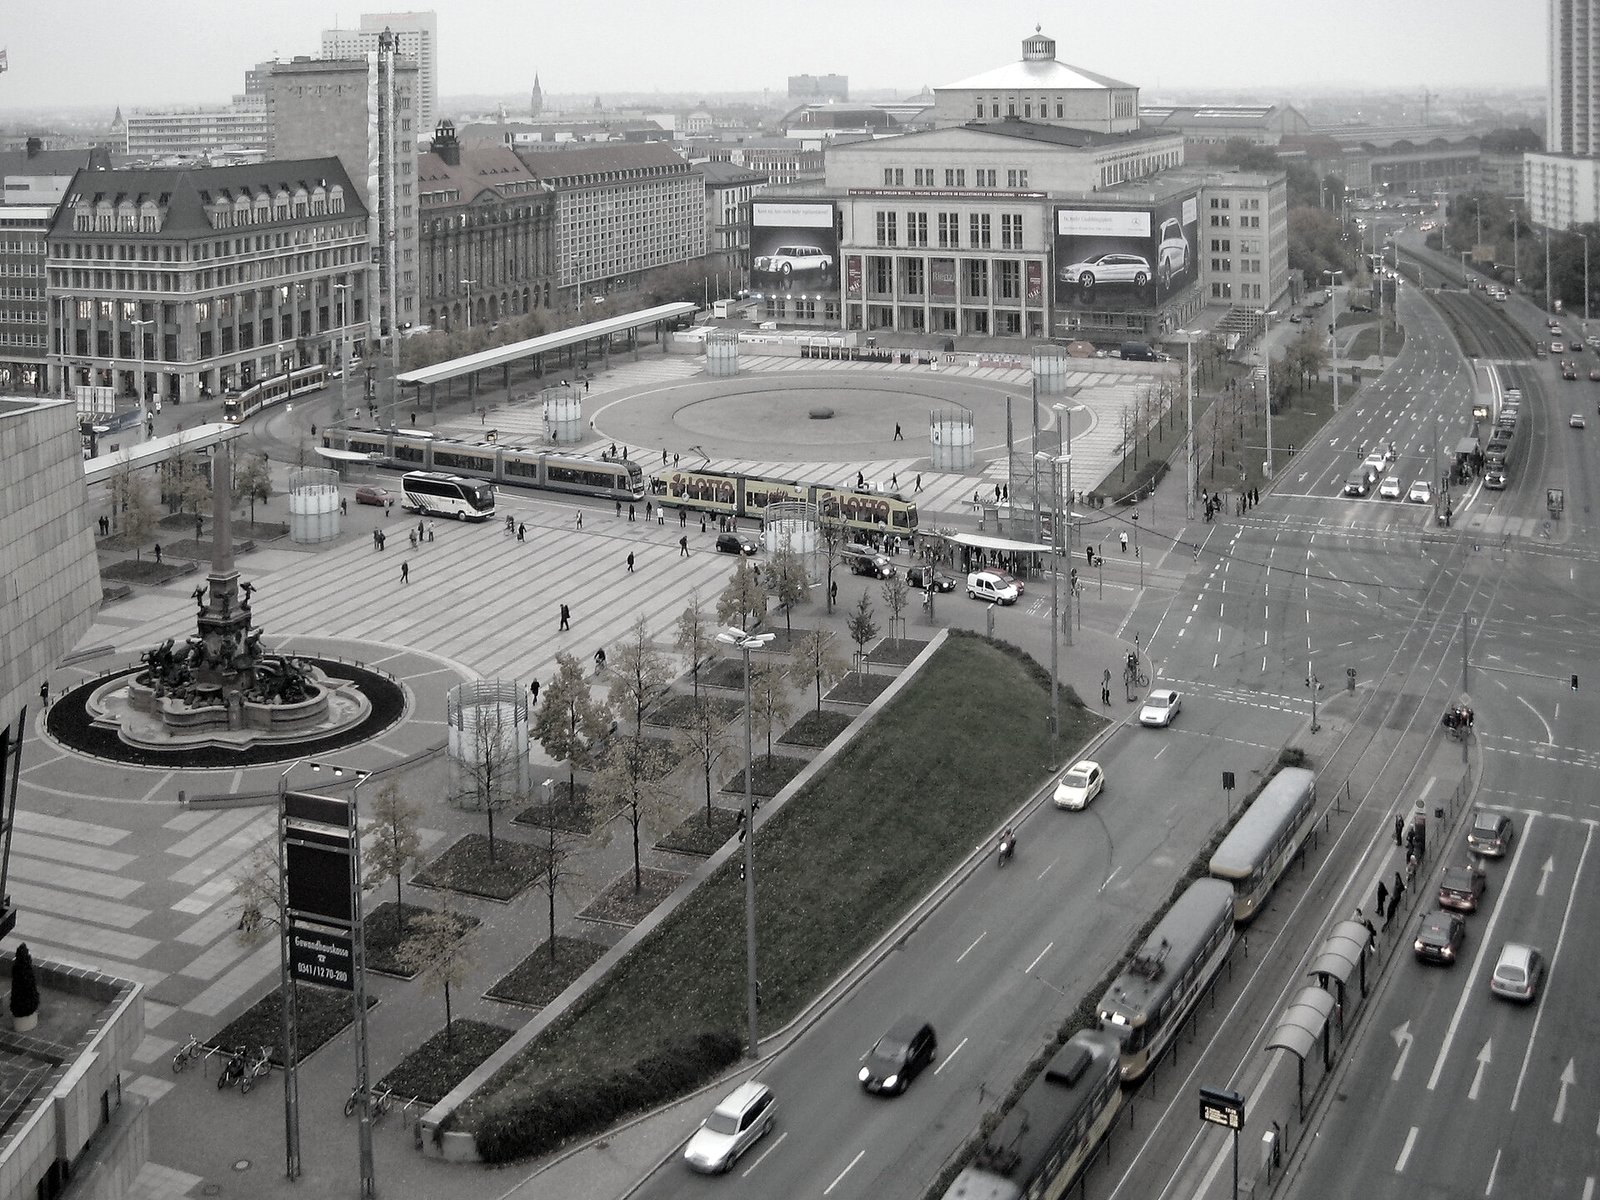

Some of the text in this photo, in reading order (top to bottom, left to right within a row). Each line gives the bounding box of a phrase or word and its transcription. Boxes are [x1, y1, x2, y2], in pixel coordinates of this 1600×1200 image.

[688, 476, 734, 496] LOTTO
[840, 495, 889, 516] LOTTO
[295, 936, 349, 957] Gewandhauskasse
